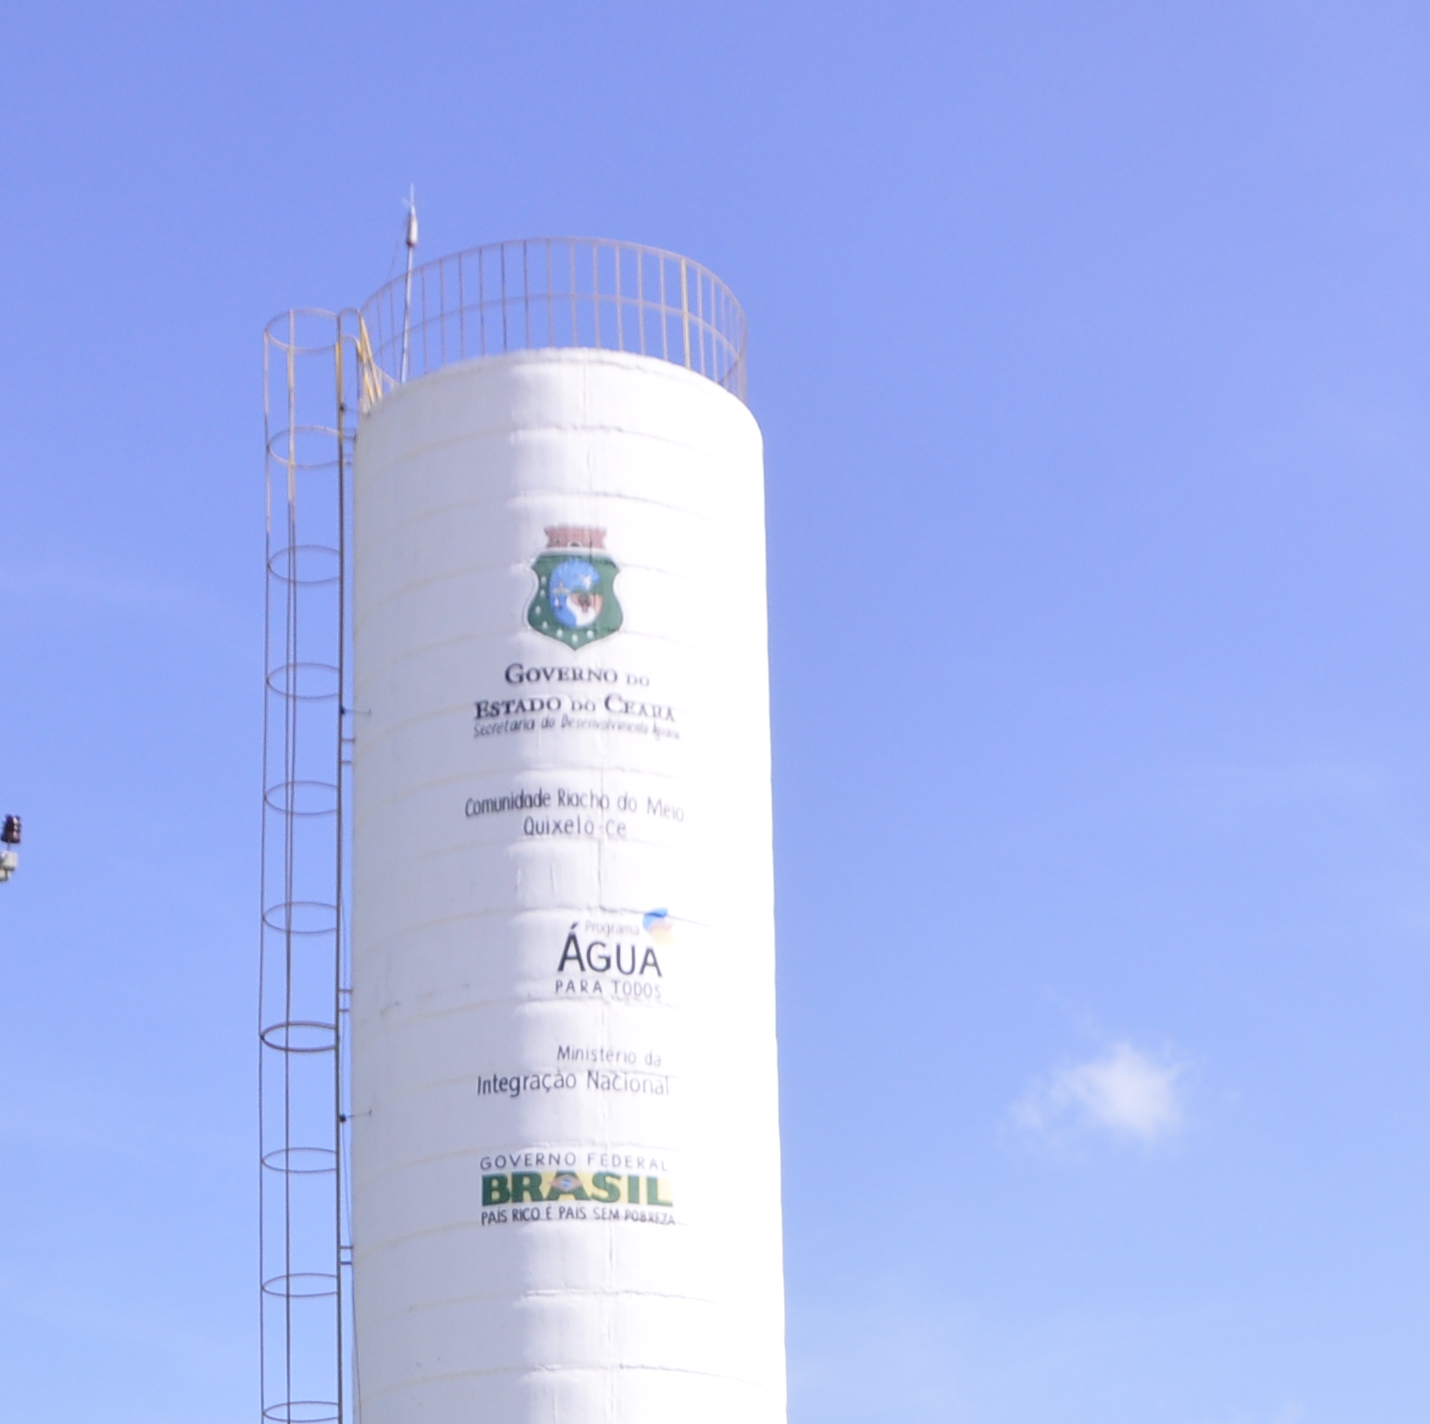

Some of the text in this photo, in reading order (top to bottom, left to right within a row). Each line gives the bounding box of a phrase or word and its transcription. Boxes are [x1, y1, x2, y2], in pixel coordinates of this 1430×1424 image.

[504, 663, 650, 687] GOVERNO DO
[474, 696, 562, 720] ESTADO
[571, 699, 596, 713] DO
[465, 787, 685, 822] Comunidade Riacho do Meio
[585, 919, 640, 937] Programa
[557, 921, 663, 978] ÁGUA
[555, 979, 662, 999] PARA TODOS
[556, 1045, 662, 1068] Ministério da
[476, 1069, 669, 1098] Integração Nacional
[479, 1152, 669, 1172] GOVERNO FEDERAL
[481, 1169, 674, 1208] BRASIL
[512, 1206, 540, 1223] RICO
[546, 1203, 553, 1220] É
[593, 1206, 619, 1221] SEM
[624, 1208, 676, 1226] POBREZA
